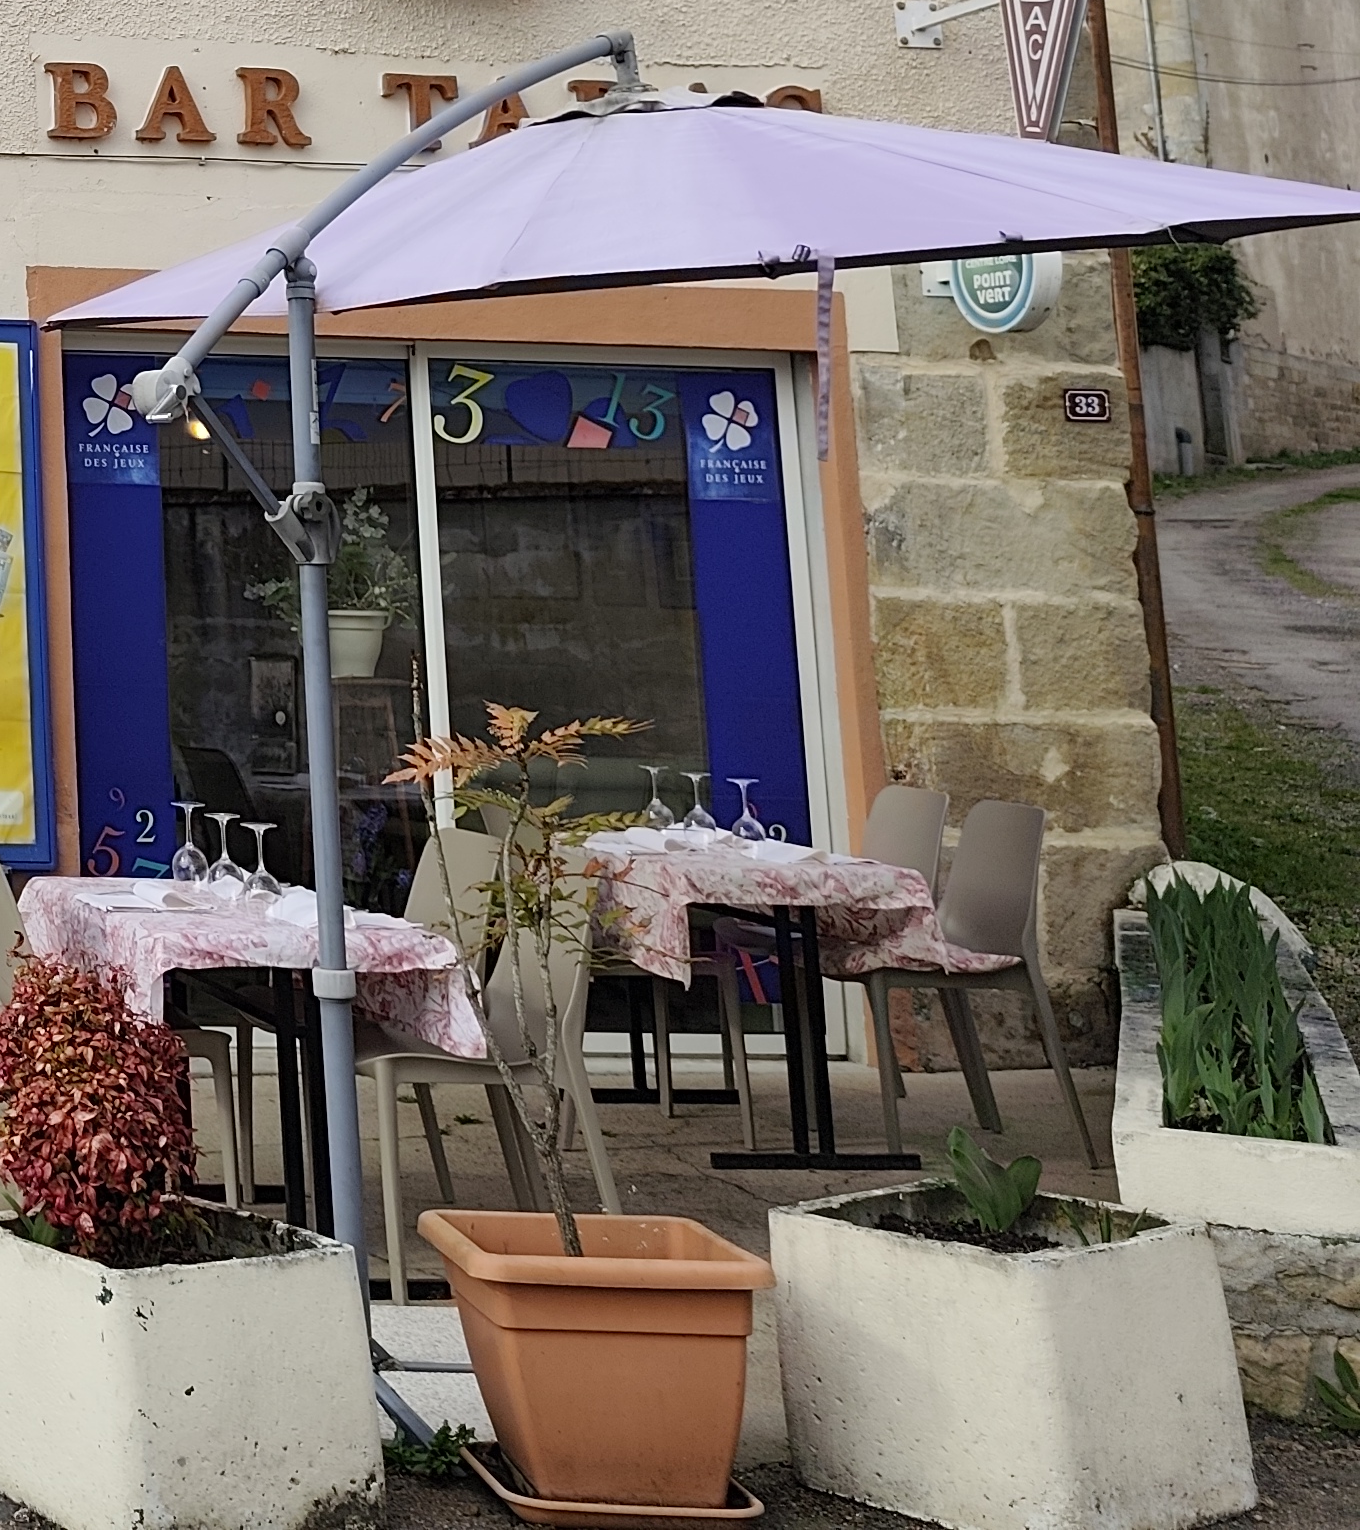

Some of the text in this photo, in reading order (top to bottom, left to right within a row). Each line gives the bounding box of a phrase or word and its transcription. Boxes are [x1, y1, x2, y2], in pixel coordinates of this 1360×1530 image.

[44, 61, 312, 150] BAR
[434, 362, 495, 444] 3
[1075, 396, 1100, 414] 33
[79, 443, 149, 457] FRANÇAISE
[84, 458, 145, 469] DES JEUX
[700, 459, 767, 473] FRANÇAISE
[705, 473, 764, 484] DES JEUX
[109, 787, 125, 810] 9
[135, 809, 156, 843] 2
[87, 825, 126, 877] 5
